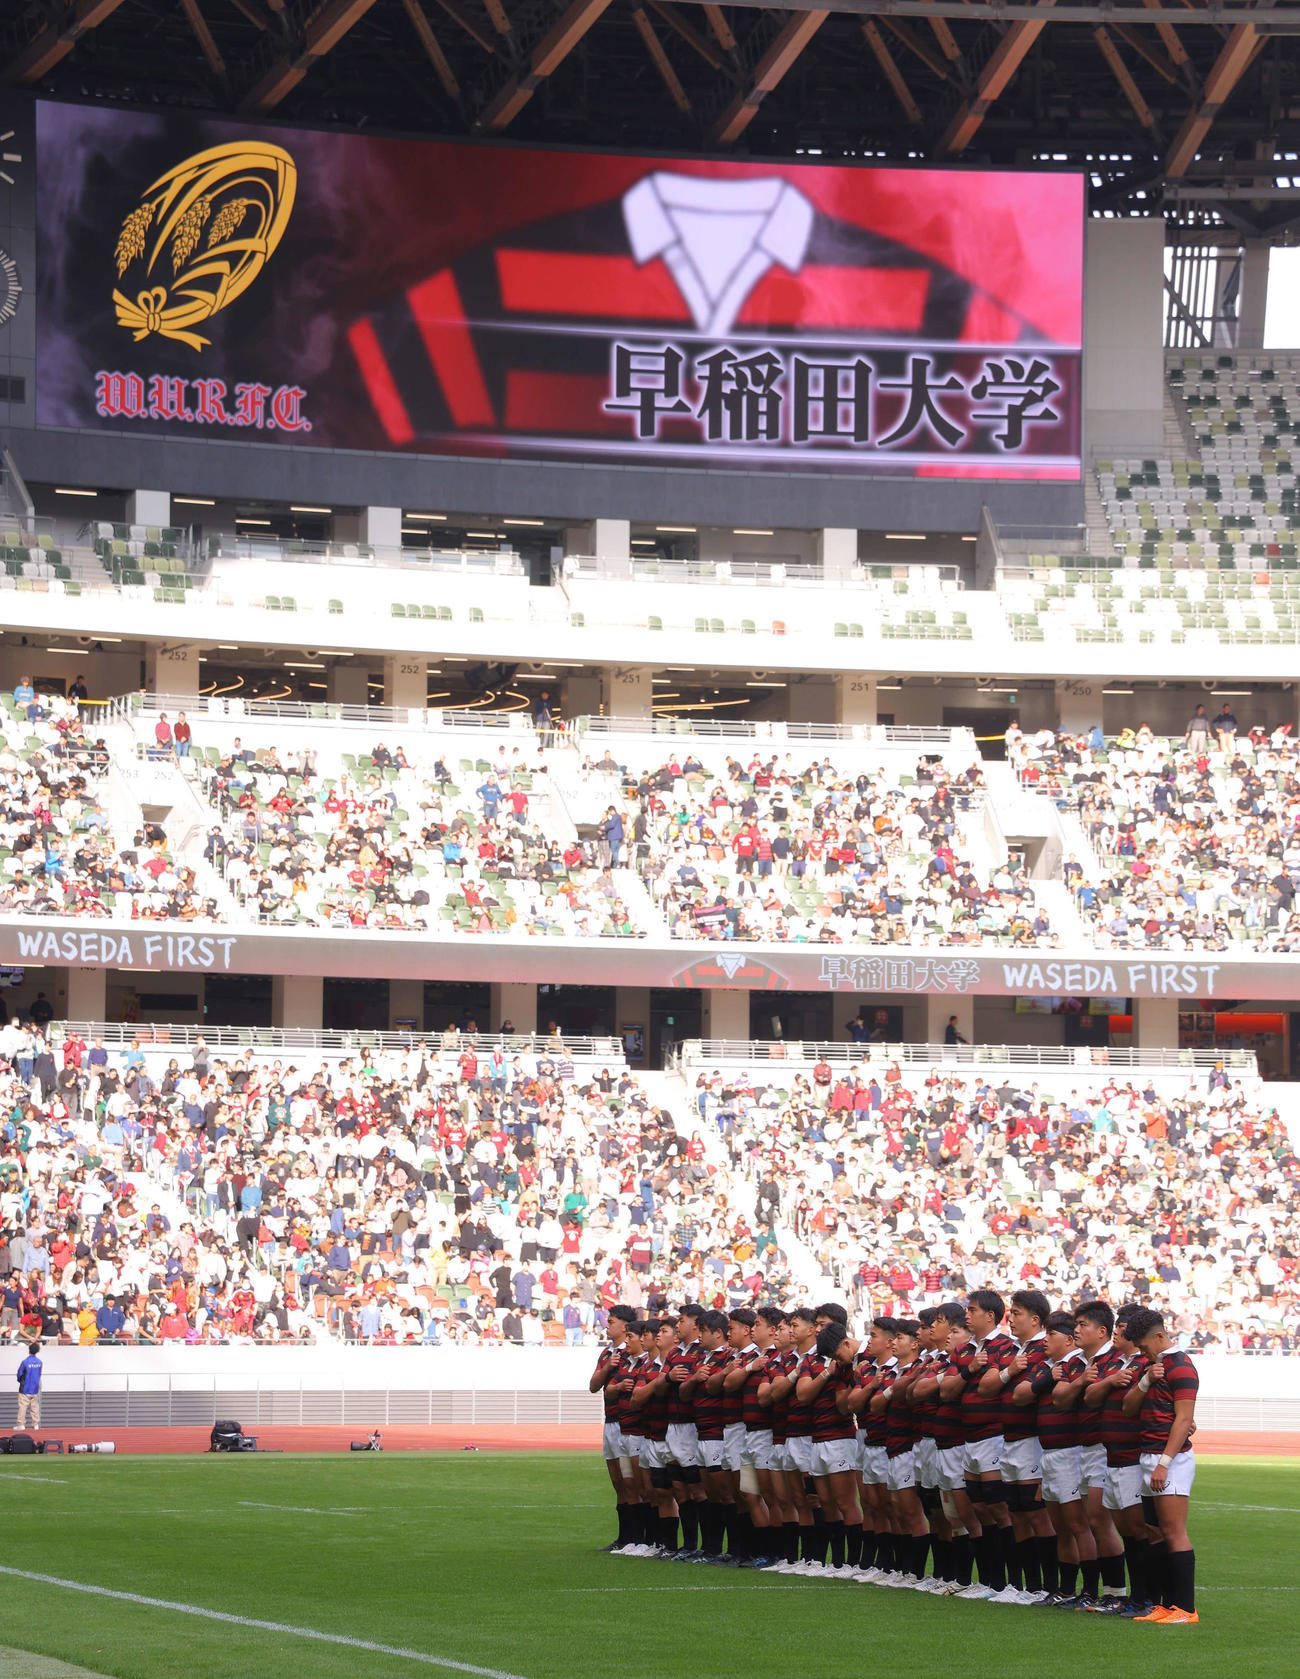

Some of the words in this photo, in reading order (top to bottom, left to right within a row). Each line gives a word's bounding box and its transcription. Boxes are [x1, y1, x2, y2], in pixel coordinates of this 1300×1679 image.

[602, 342, 1062, 451] 早稲田大学
[168, 651, 187, 661] 252
[400, 665, 419, 674] 252
[622, 675, 640, 683] 251
[850, 682, 869, 691] 251
[1072, 687, 1092, 695] 250
[18, 931, 133, 965] WASEDA
[144, 935, 238, 969] FIRST
[818, 956, 980, 993] 早稲田大学
[1003, 963, 1117, 993] WASEDA
[1128, 964, 1220, 996] FIRST
